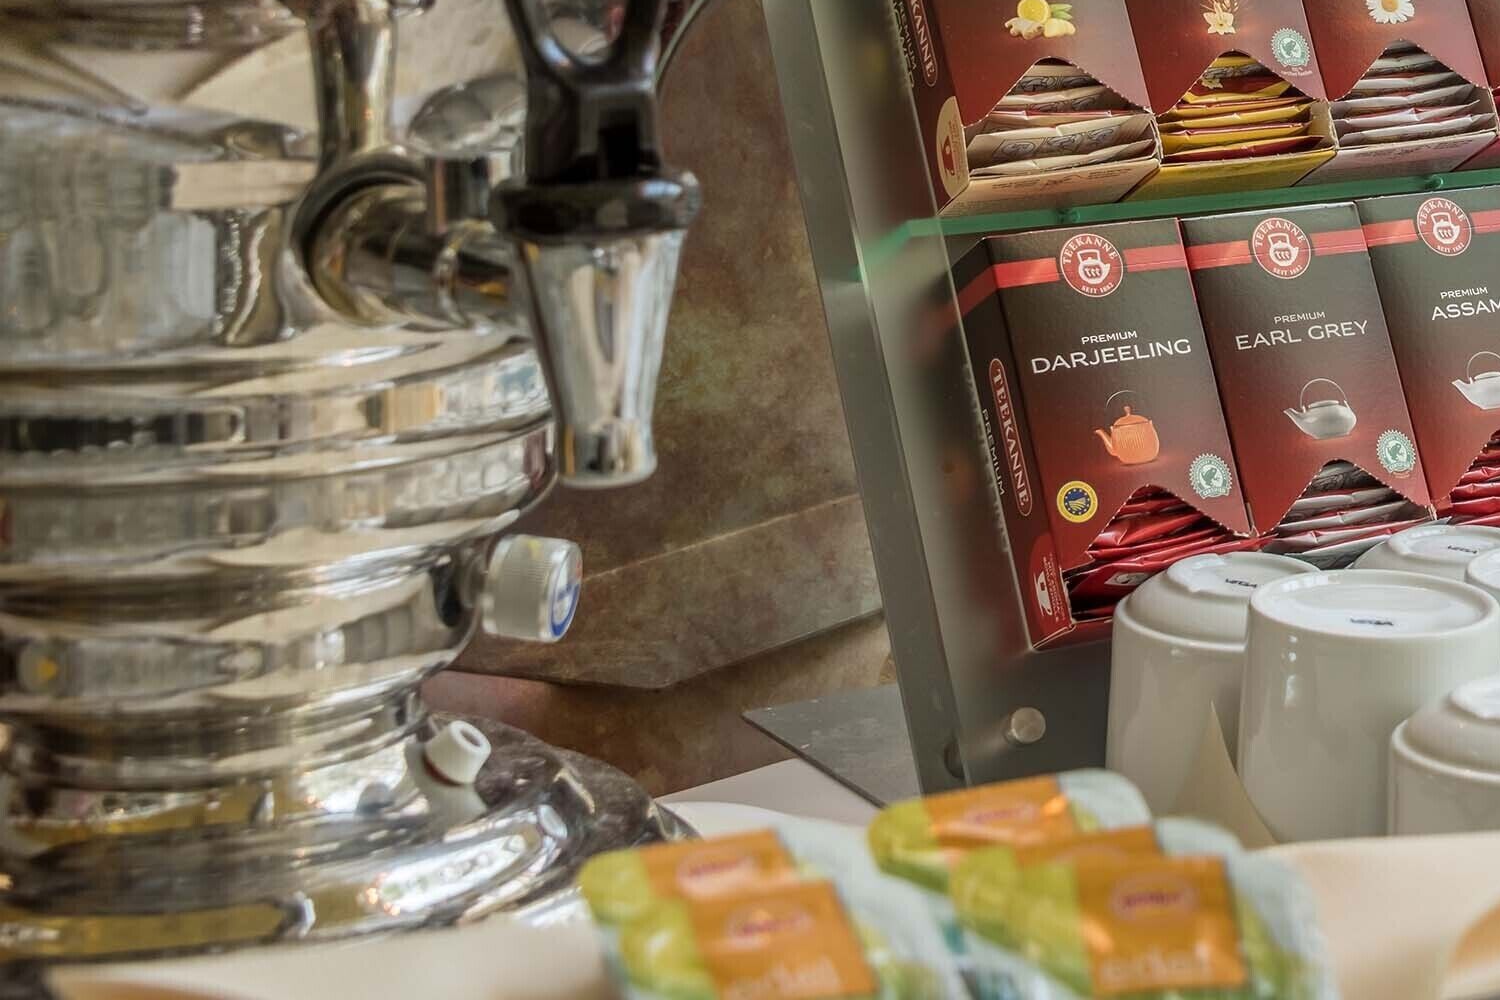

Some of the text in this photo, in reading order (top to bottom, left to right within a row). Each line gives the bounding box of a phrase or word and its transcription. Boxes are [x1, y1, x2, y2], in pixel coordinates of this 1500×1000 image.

[1419, 200, 1467, 226] TEEKANNE
[1255, 220, 1306, 247] TEEKANNE
[1063, 235, 1119, 265] TEEKANNE
[1440, 286, 1488, 299] PREMIUM
[1273, 311, 1326, 324] PREMIUM
[1081, 330, 1138, 345] PREMIUM
[1235, 320, 1368, 350] EARL GREY
[1031, 338, 1192, 374] DARJEELING
[993, 367, 1029, 507] TEEKANNE
[982, 408, 1006, 496] PREMIUM
